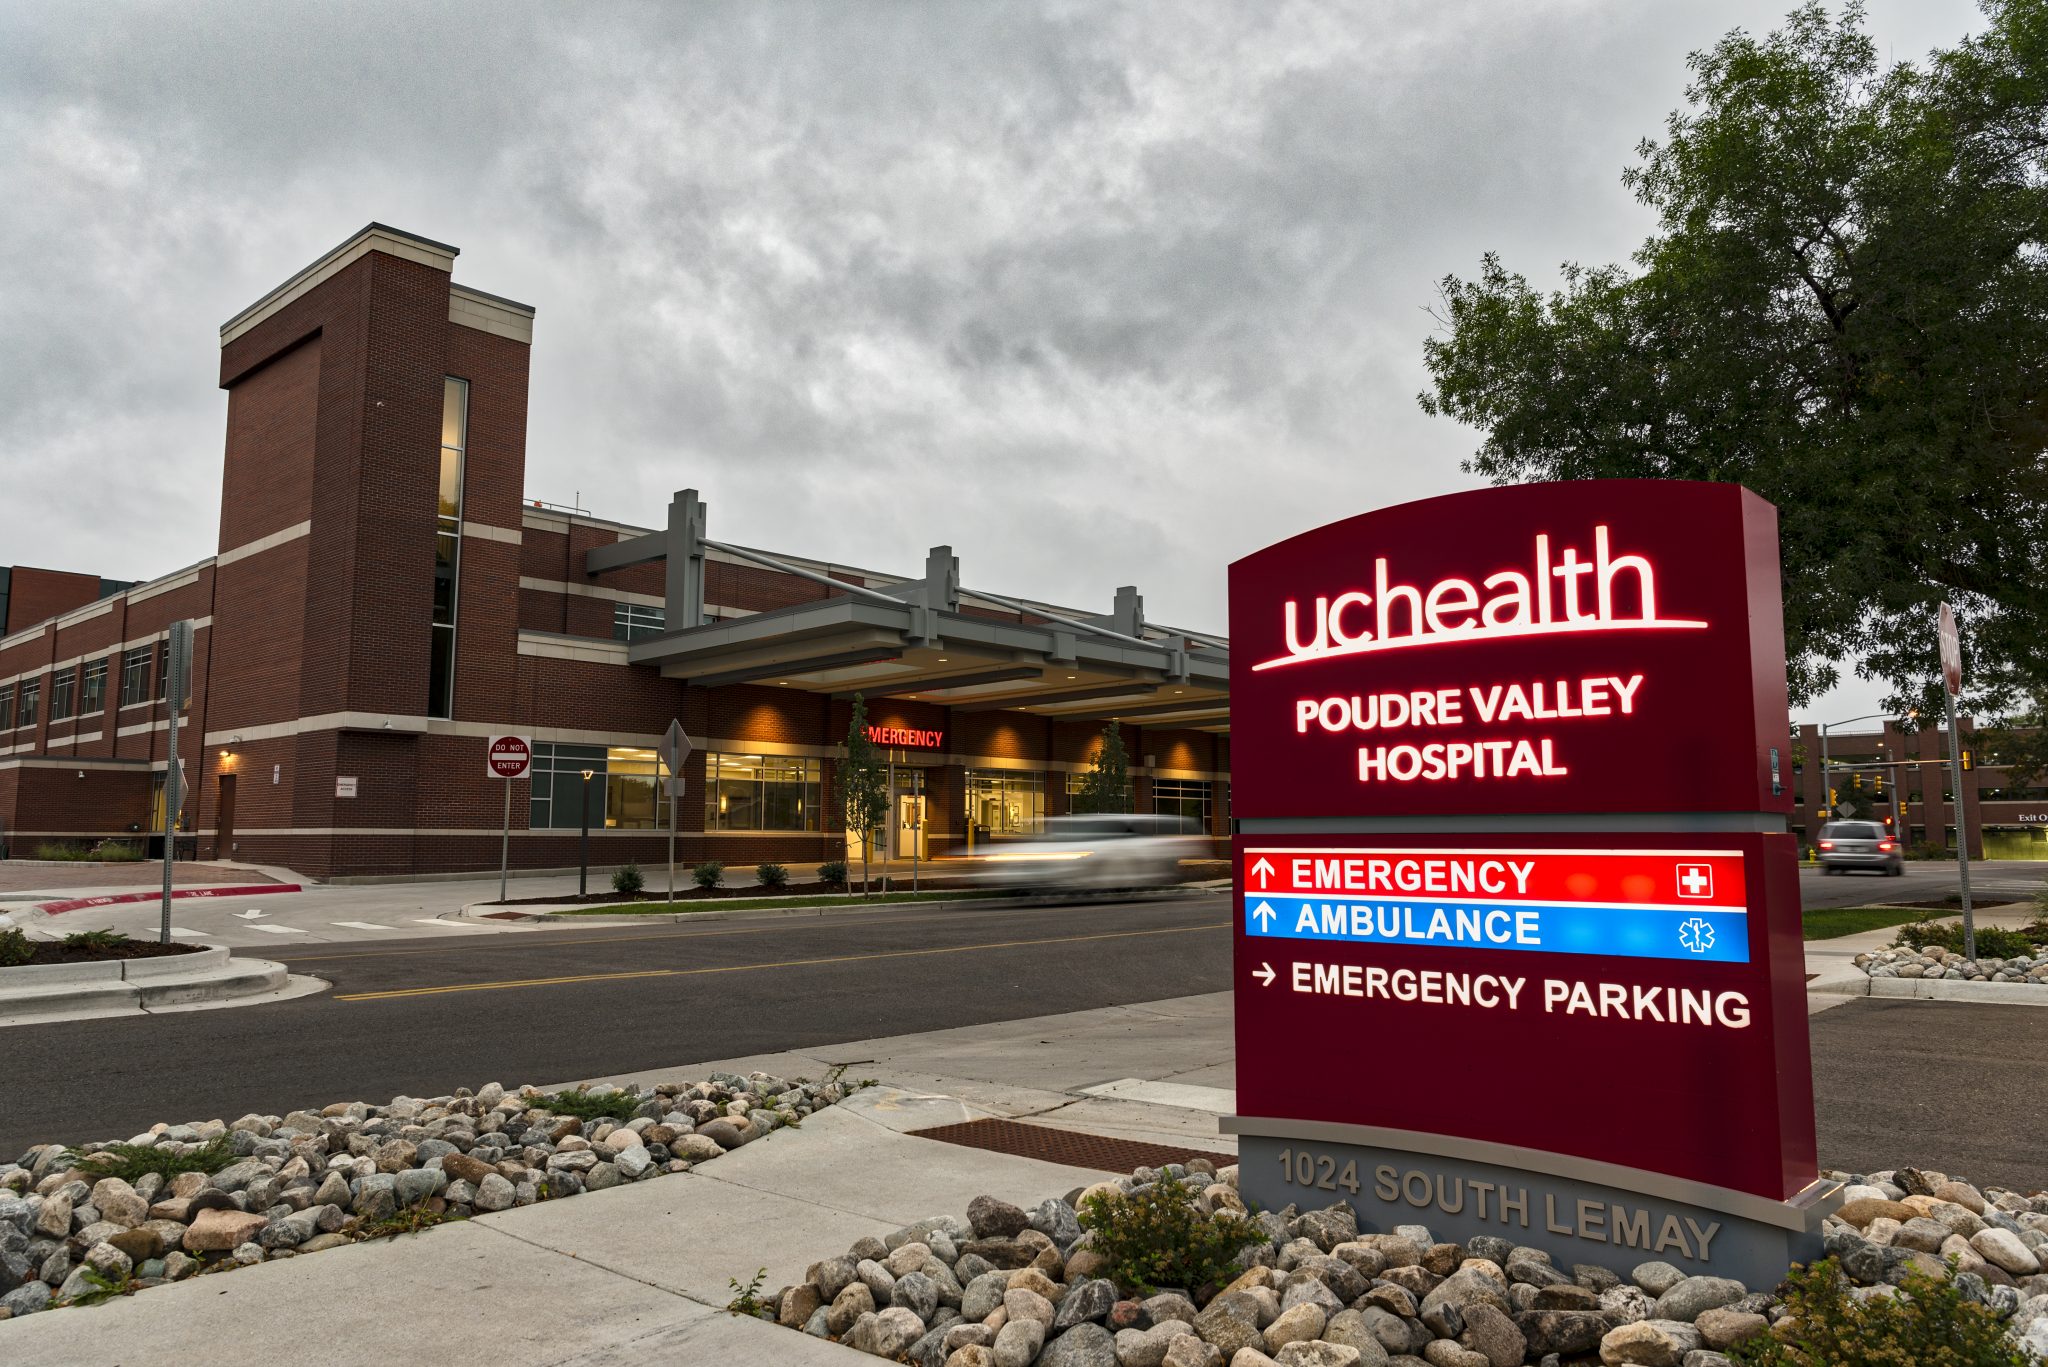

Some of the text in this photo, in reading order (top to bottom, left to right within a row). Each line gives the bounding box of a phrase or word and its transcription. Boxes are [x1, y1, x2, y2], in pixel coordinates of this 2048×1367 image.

[1284, 525, 1656, 655] uchealth
[1941, 631, 1959, 669] STOP
[1296, 675, 1644, 733] POUDRE VALLEY
[1358, 739, 1568, 781] HOSPITAL
[1291, 858, 1536, 894] EMERGENCY
[1294, 904, 1542, 945] AMBULANCE
[1291, 961, 1752, 1029] EMERGENCY PARKING
[1278, 1148, 1721, 1261] 1024 SOUTH LEMAY
